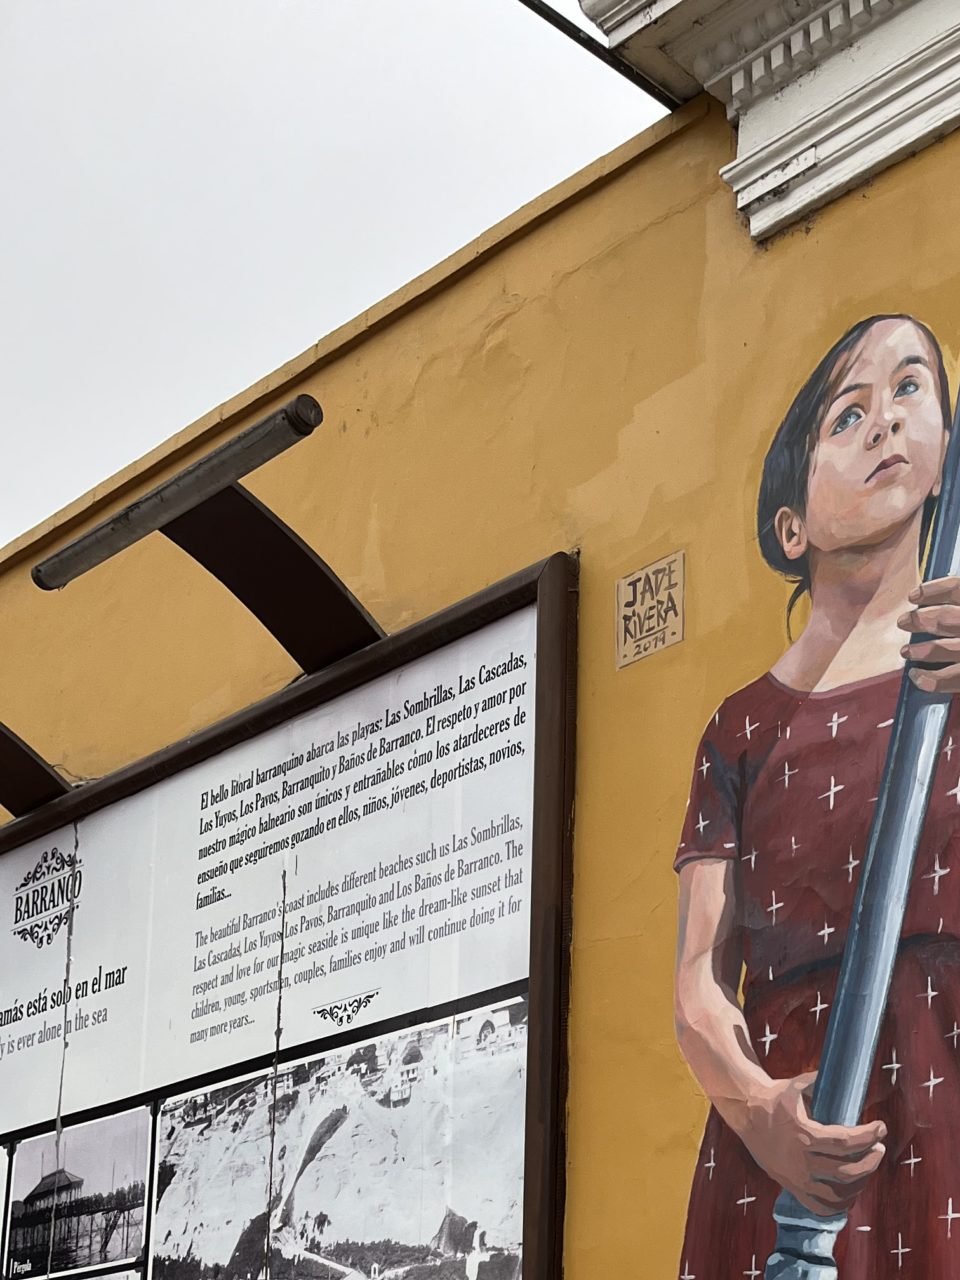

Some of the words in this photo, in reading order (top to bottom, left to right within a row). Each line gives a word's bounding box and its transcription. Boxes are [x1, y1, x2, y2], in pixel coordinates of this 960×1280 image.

[198, 839, 227, 860] nuestro
[229, 827, 257, 847] mágico
[259, 805, 296, 835] balneario
[297, 802, 313, 818] son
[315, 788, 343, 810] únicos
[345, 784, 351, 800] y
[353, 759, 405, 794] entrañables
[436, 740, 451, 760] los
[453, 724, 510, 753] atardeceres
[513, 706, 526, 727] de
[200, 818, 213, 835] Los
[214, 810, 238, 829] Yuyos,
[240, 800, 253, 817] Los
[255, 791, 280, 811] Pavos,
[282, 766, 330, 800] Barranquito
[332, 765, 337, 778] y
[338, 752, 365, 774] Baños
[367, 743, 378, 762] de
[379, 730, 424, 758] Barranco.
[426, 715, 436, 736] El
[437, 705, 472, 732] respeto
[474, 702, 480, 719] y
[481, 691, 508, 713] amor
[509, 681, 527, 705] por
[201, 792, 208, 810] El
[210, 784, 228, 806] bello
[231, 771, 253, 798] litoral
[256, 753, 304, 785] barranquino
[306, 743, 335, 763] abarca
[337, 731, 349, 749] las
[352, 719, 383, 746] playas:
[385, 709, 400, 728] Las
[404, 684, 456, 720] Sombrillas,
[459, 675, 475, 695] Las
[479, 652, 527, 685] Cascadas,
[197, 861, 228, 885] ensueño
[229, 856, 244, 874] que
[245, 837, 290, 865] seguiremos
[291, 817, 325, 849] gozando
[326, 815, 337, 831] en
[338, 805, 361, 826] ellos,
[363, 794, 389, 816] niños,
[389, 779, 428, 810] jóvenes,
[430, 756, 487, 790] deportistas,
[489, 740, 525, 765] novios,
[14, 869, 83, 924] BARRANCO
[192, 975, 218, 996] respect
[220, 966, 234, 986] and
[236, 962, 250, 980] love
[253, 956, 265, 975] for
[266, 954, 279, 969] our
[281, 942, 305, 965] magic
[308, 931, 338, 955] seaside
[341, 927, 348, 944] is
[351, 920, 380, 941] unique
[382, 911, 399, 930] like
[401, 905, 416, 923] the
[418, 886, 468, 918] dream-like
[470, 875, 501, 901] sunset
[504, 868, 523, 889] that
[193, 956, 206, 972] Las
[207, 940, 242, 968] Cascadas,
[244, 936, 257, 954] Los
[284, 921, 298, 939] Los
[300, 914, 325, 933] Pavos,
[327, 893, 376, 923] Barranquito
[378, 883, 395, 902] and
[396, 881, 413, 899] Los
[414, 872, 442, 893] Baños
[444, 863, 455, 883] de
[457, 852, 503, 879] Barranco.
[505, 840, 524, 861] The
[195, 931, 209, 948] The
[210, 916, 241, 943] beautiful
[284, 896, 305, 914] coast
[307, 881, 339, 903] includes
[341, 867, 377, 893] different
[379, 854, 414, 879] beaches
[415, 843, 437, 866] such
[439, 843, 450, 858] us
[452, 834, 468, 853] Las
[470, 814, 523, 846] Sombrillas,
[196, 886, 232, 910] familias...
[26, 988, 48, 1017] está
[50, 979, 72, 1009] solo
[75, 980, 88, 1000] en
[91, 965, 102, 994] el
[104, 966, 128, 990] mar
[191, 997, 222, 1020] children,
[223, 991, 248, 1011] young,
[294, 961, 327, 985] couples,
[329, 950, 362, 973] families
[364, 941, 387, 962] enjoy
[390, 931, 406, 953] and
[409, 925, 425, 946] will
[427, 918, 467, 941] continue
[470, 907, 495, 928] doing
[498, 900, 505, 918] it
[508, 895, 522, 915] for
[7, 1034, 15, 1055] is
[17, 1033, 36, 1051] ever
[37, 1021, 62, 1044] alone
[75, 1008, 89, 1031] the
[91, 1008, 108, 1026] sea
[190, 1027, 208, 1043] many
[210, 1024, 228, 1037] more
[229, 1014, 255, 1035] years...
